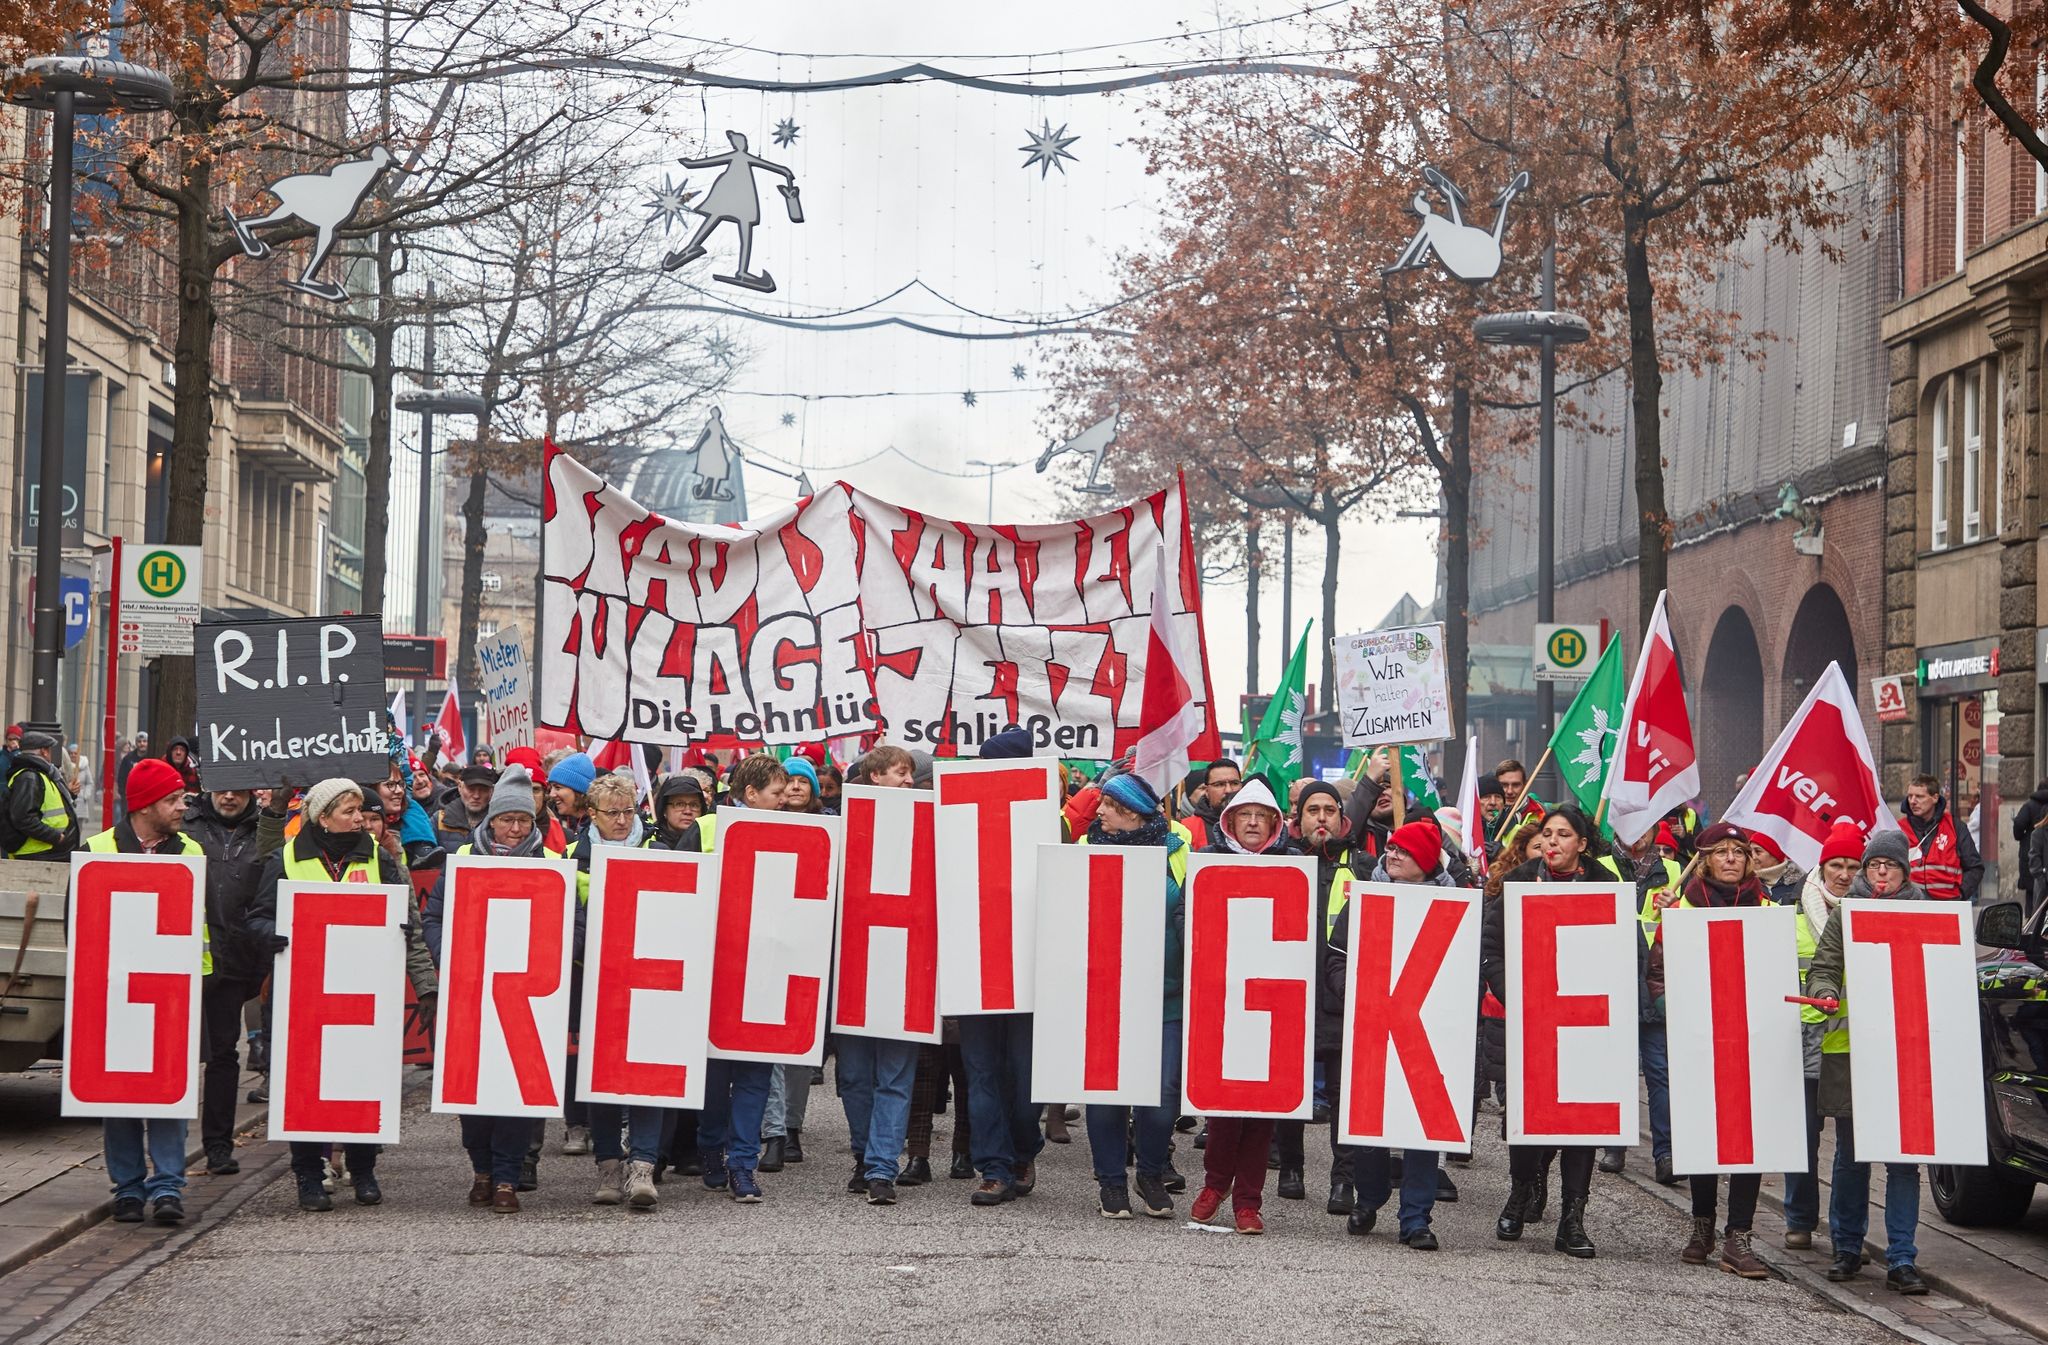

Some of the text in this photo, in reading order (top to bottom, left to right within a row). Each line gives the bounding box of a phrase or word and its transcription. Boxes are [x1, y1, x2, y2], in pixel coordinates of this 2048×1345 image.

[151, 561, 174, 587] H
[139, 604, 198, 613] Mönckebergstraße
[214, 624, 356, 693] R.I.P.
[480, 640, 521, 675] Mieten
[1558, 637, 1576, 658] H
[1368, 656, 1405, 680] WIR
[488, 673, 518, 704] runter
[1373, 683, 1409, 703] halten
[492, 702, 528, 735] Löhne
[631, 698, 697, 733] Die
[904, 710, 1099, 749] schlißen
[1352, 707, 1432, 737] ZUSAMMEN
[210, 711, 390, 762] Kinderschutz
